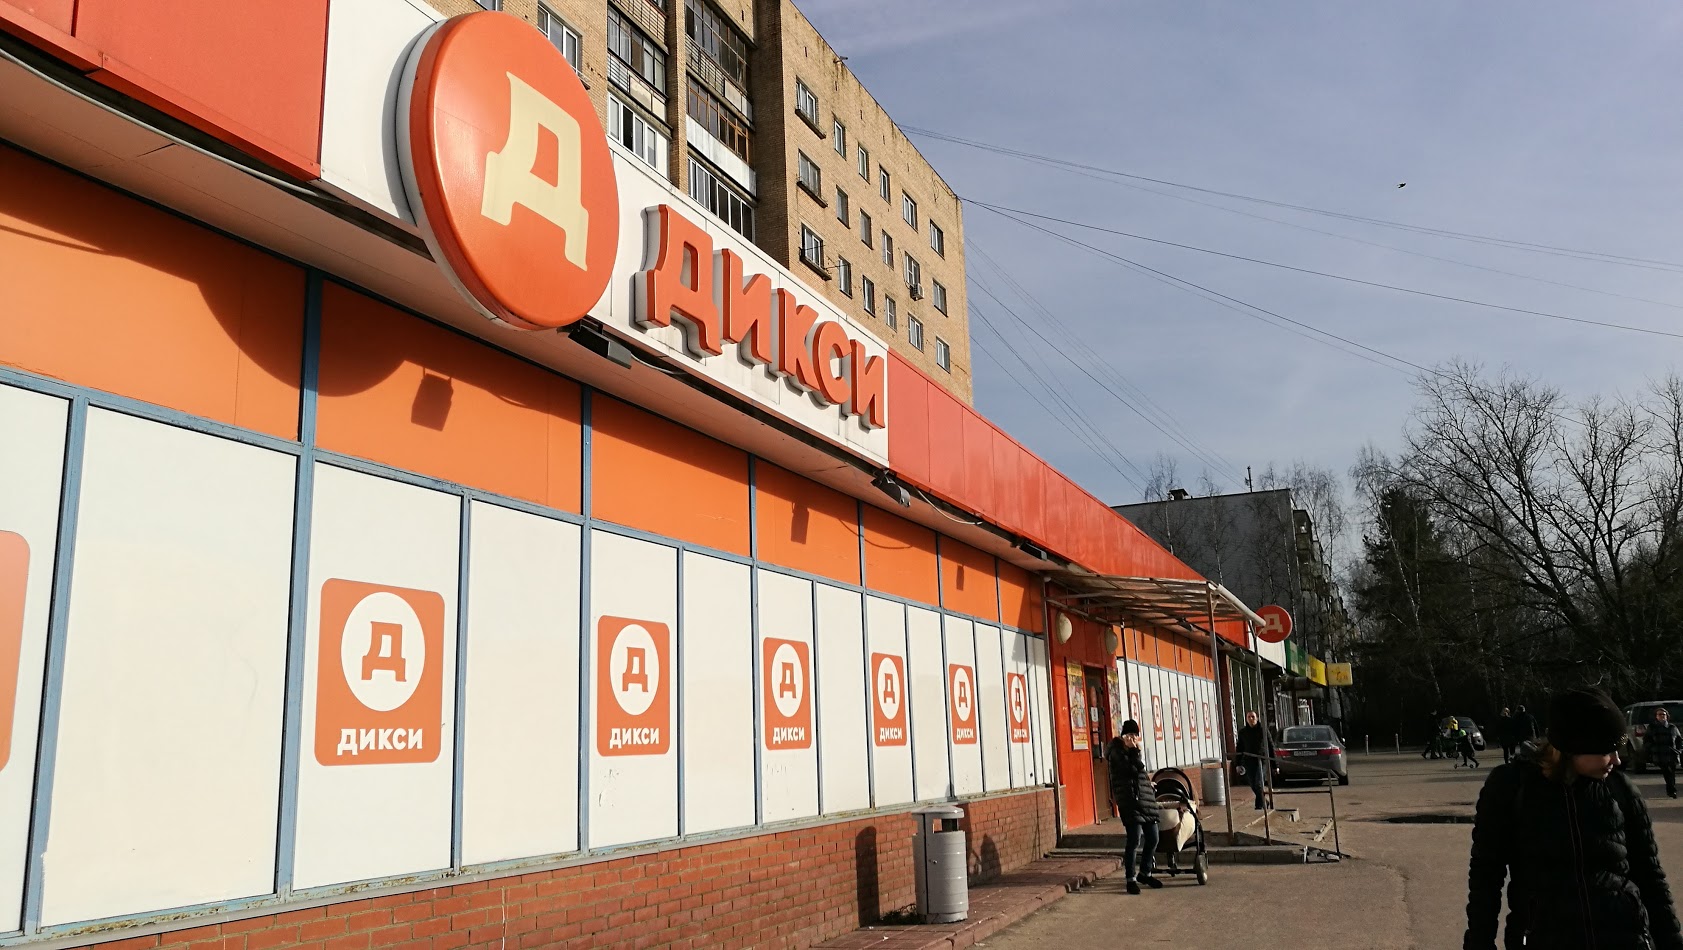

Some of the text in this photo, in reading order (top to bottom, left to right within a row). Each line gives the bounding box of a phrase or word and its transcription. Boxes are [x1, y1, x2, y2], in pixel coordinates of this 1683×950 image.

[480, 71, 589, 272] Д
[643, 203, 886, 430] ДИКСИ
[1261, 613, 1284, 635] Д
[361, 620, 407, 683] Д
[622, 646, 649, 693] Д
[779, 661, 797, 699] Д
[883, 672, 896, 704] Д
[958, 681, 968, 708] Д
[337, 728, 423, 756] ДИКСИ
[609, 727, 660, 749] ДИКСИ
[773, 726, 805, 744] ДИКСИ
[879, 727, 903, 742] ДИКСИ
[956, 727, 974, 740] ДИКСИ
